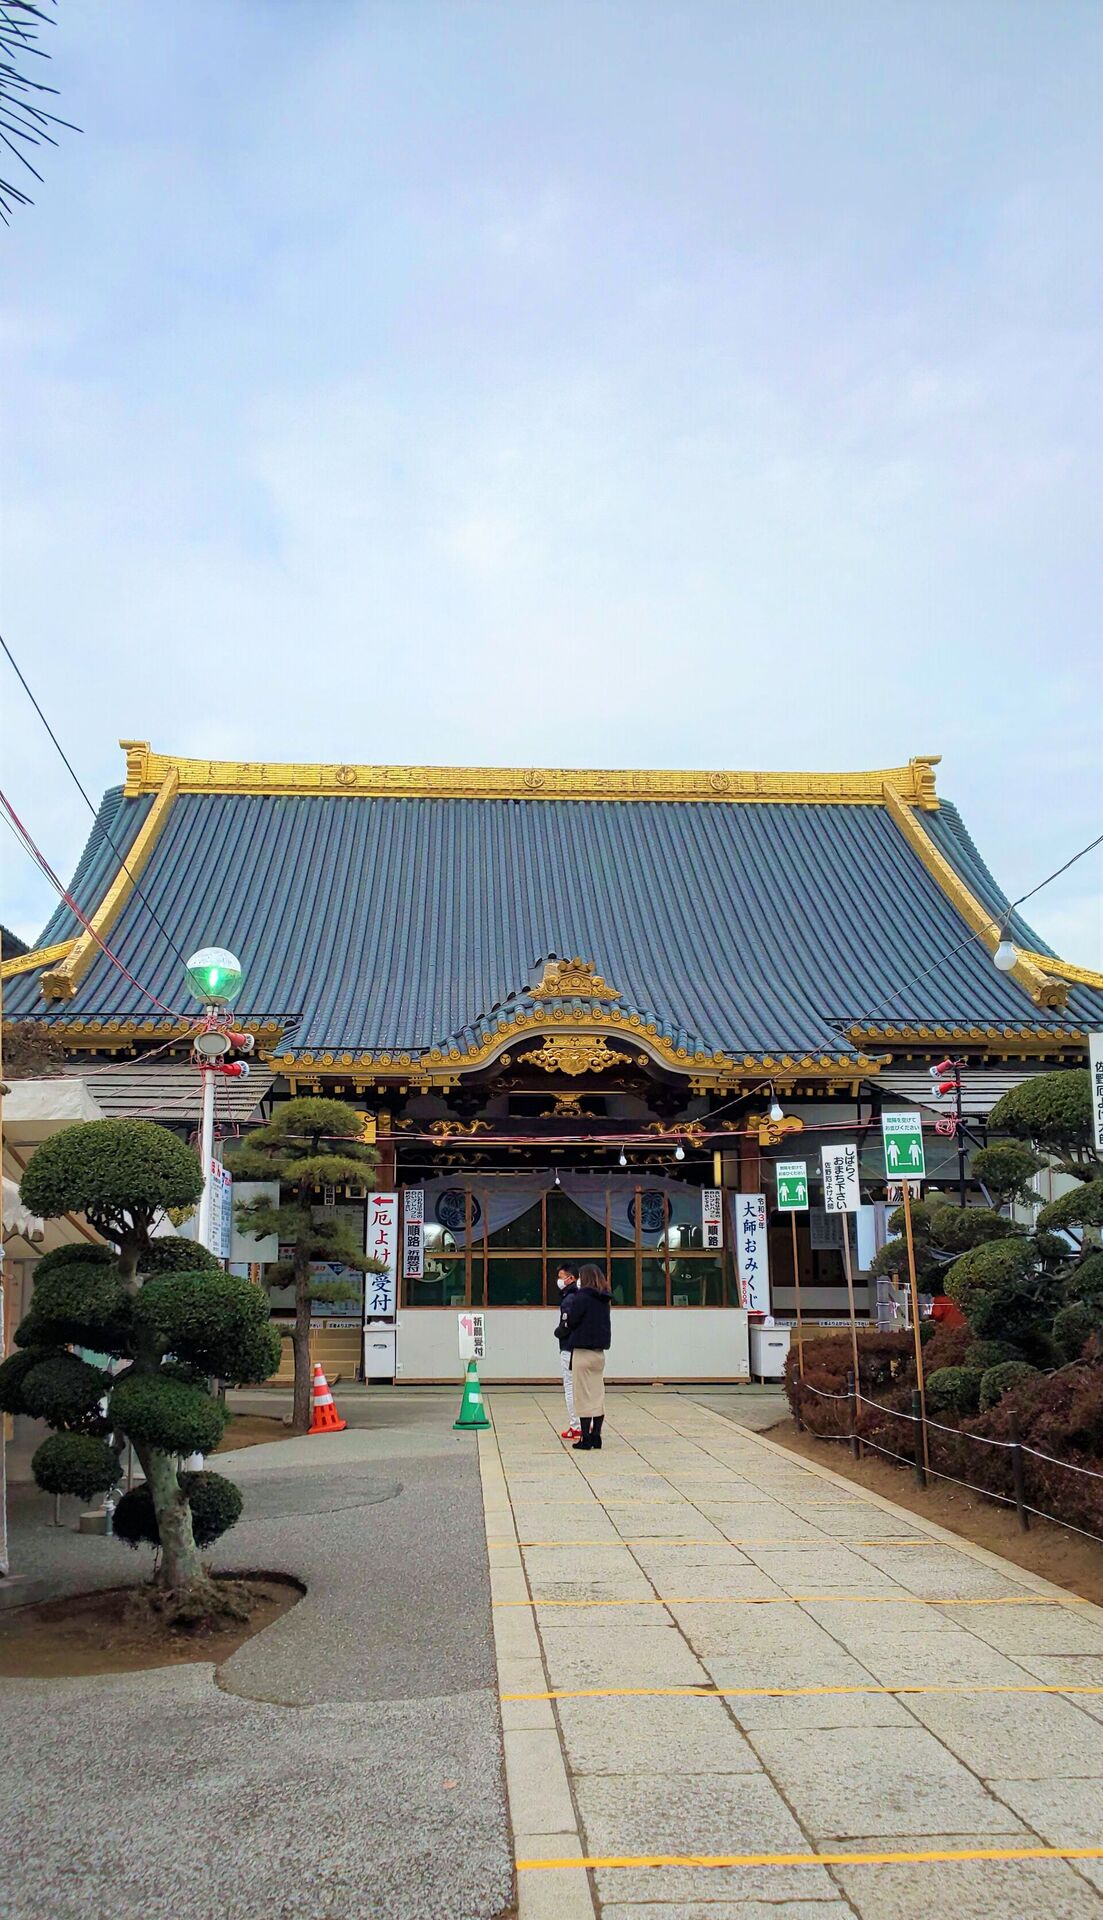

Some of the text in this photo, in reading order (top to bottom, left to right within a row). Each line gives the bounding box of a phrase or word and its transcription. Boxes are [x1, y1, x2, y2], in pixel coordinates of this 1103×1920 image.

[833, 1156, 847, 1210] おまち下さい
[845, 1147, 856, 1183] しばらく
[757, 1197, 765, 1229] 令和3年
[407, 1225, 420, 1247] 順路
[708, 1225, 719, 1246] 順路
[370, 1210, 392, 1312] 厄よけ受付
[407, 1249, 420, 1273] 祈願受付
[743, 1201, 758, 1310] 大師おみくじ
[473, 1317, 484, 1356] 祈願受付
